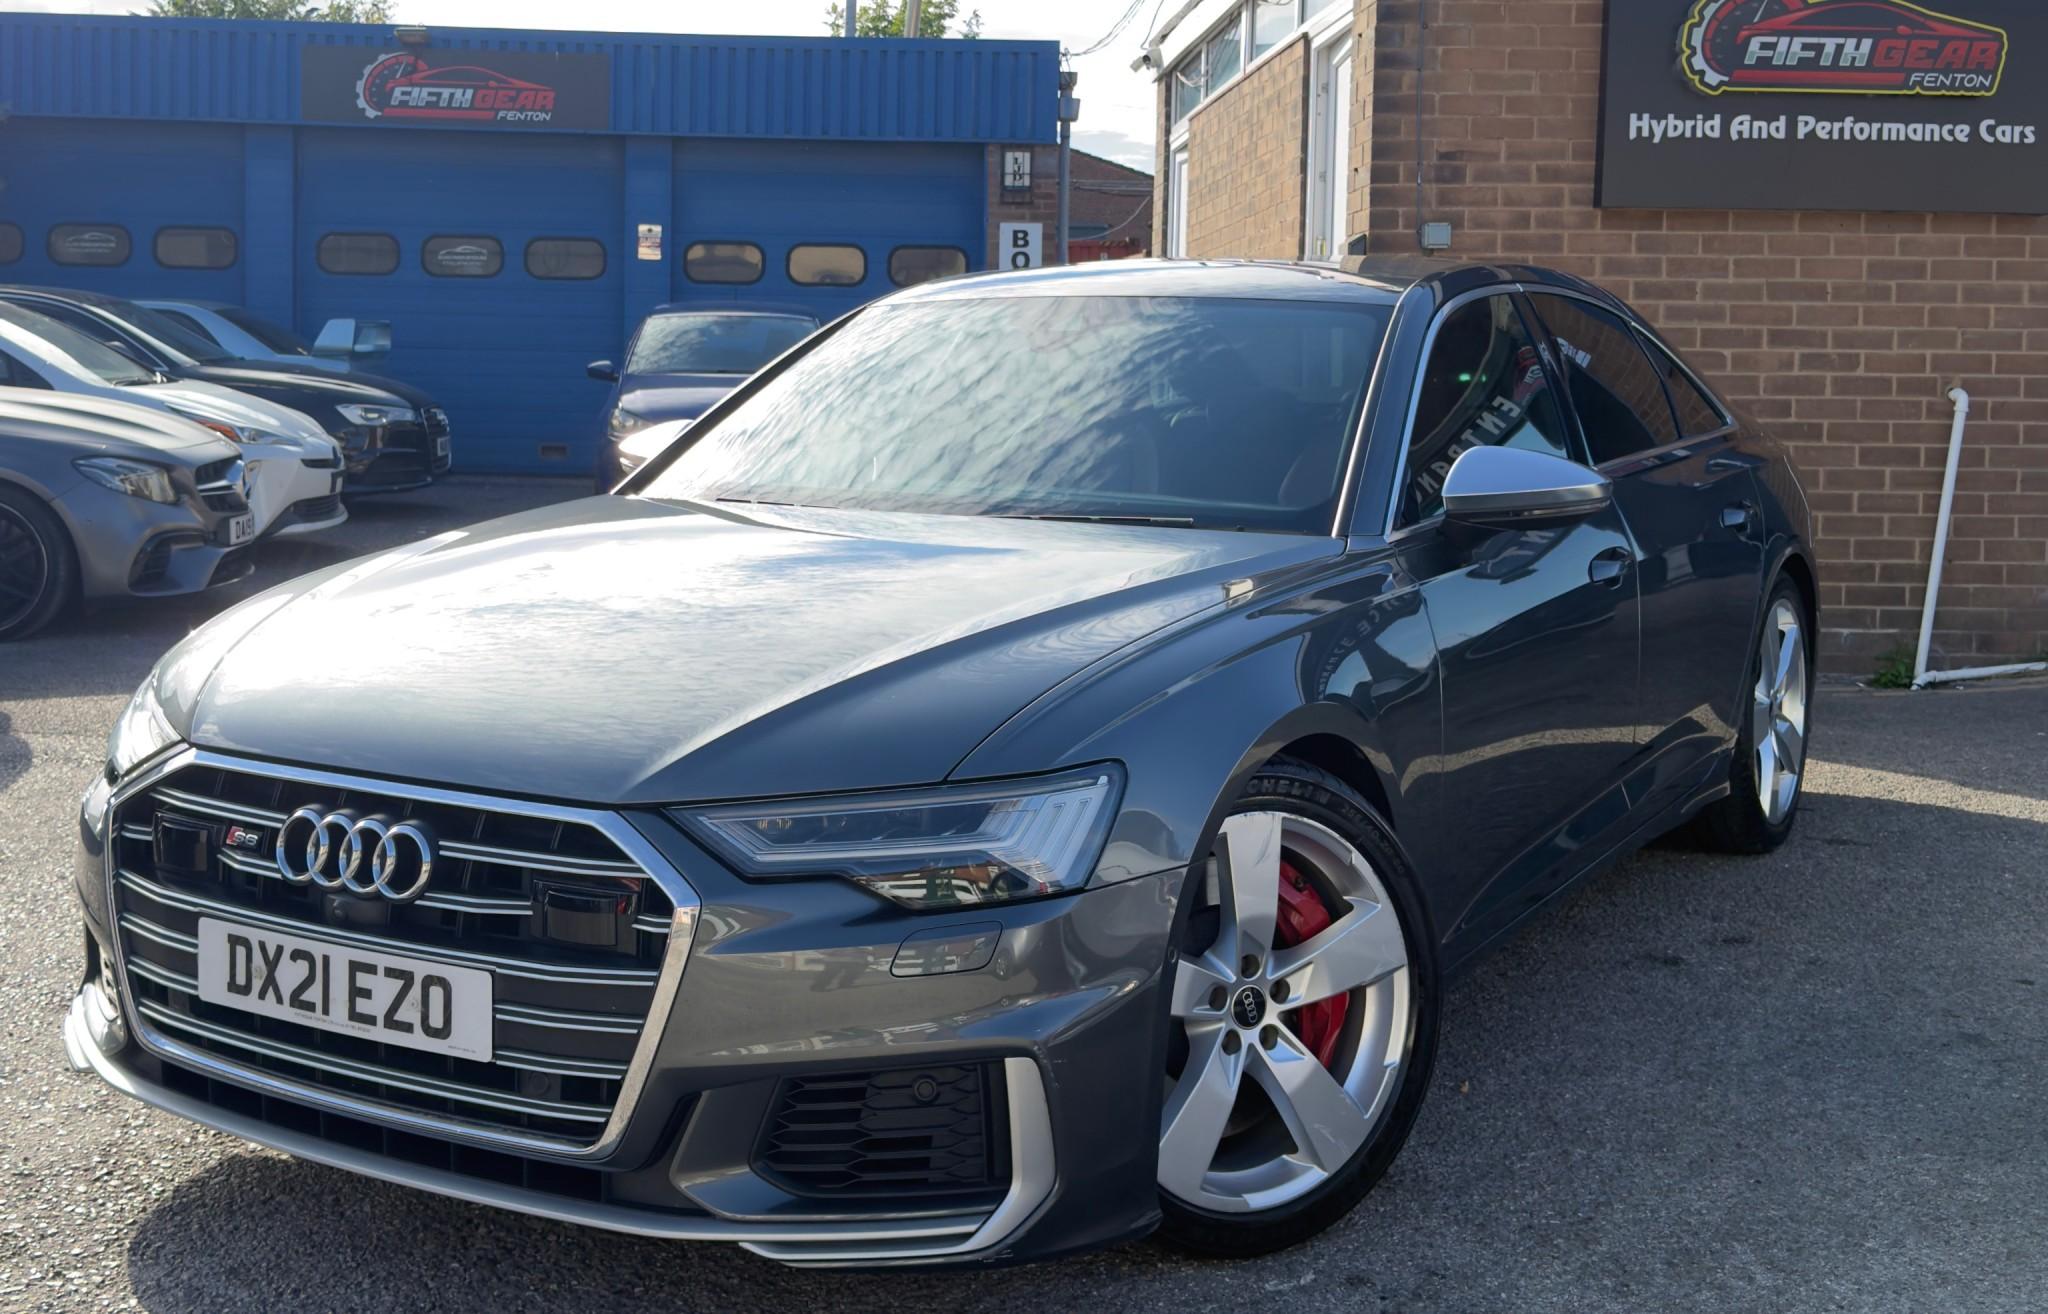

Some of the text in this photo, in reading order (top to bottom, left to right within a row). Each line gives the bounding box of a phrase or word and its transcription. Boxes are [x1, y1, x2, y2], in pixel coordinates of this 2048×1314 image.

[1744, 36, 2001, 70] FIFTH GEAR
[1909, 73, 1992, 88] FENTON
[391, 86, 555, 110] FIFTH GEAR
[496, 110, 552, 121] FENTON
[1629, 113, 2036, 143] Hybrid And Performance Cars
[234, 831, 259, 846] S6
[226, 933, 453, 1041] DX21 EZO
